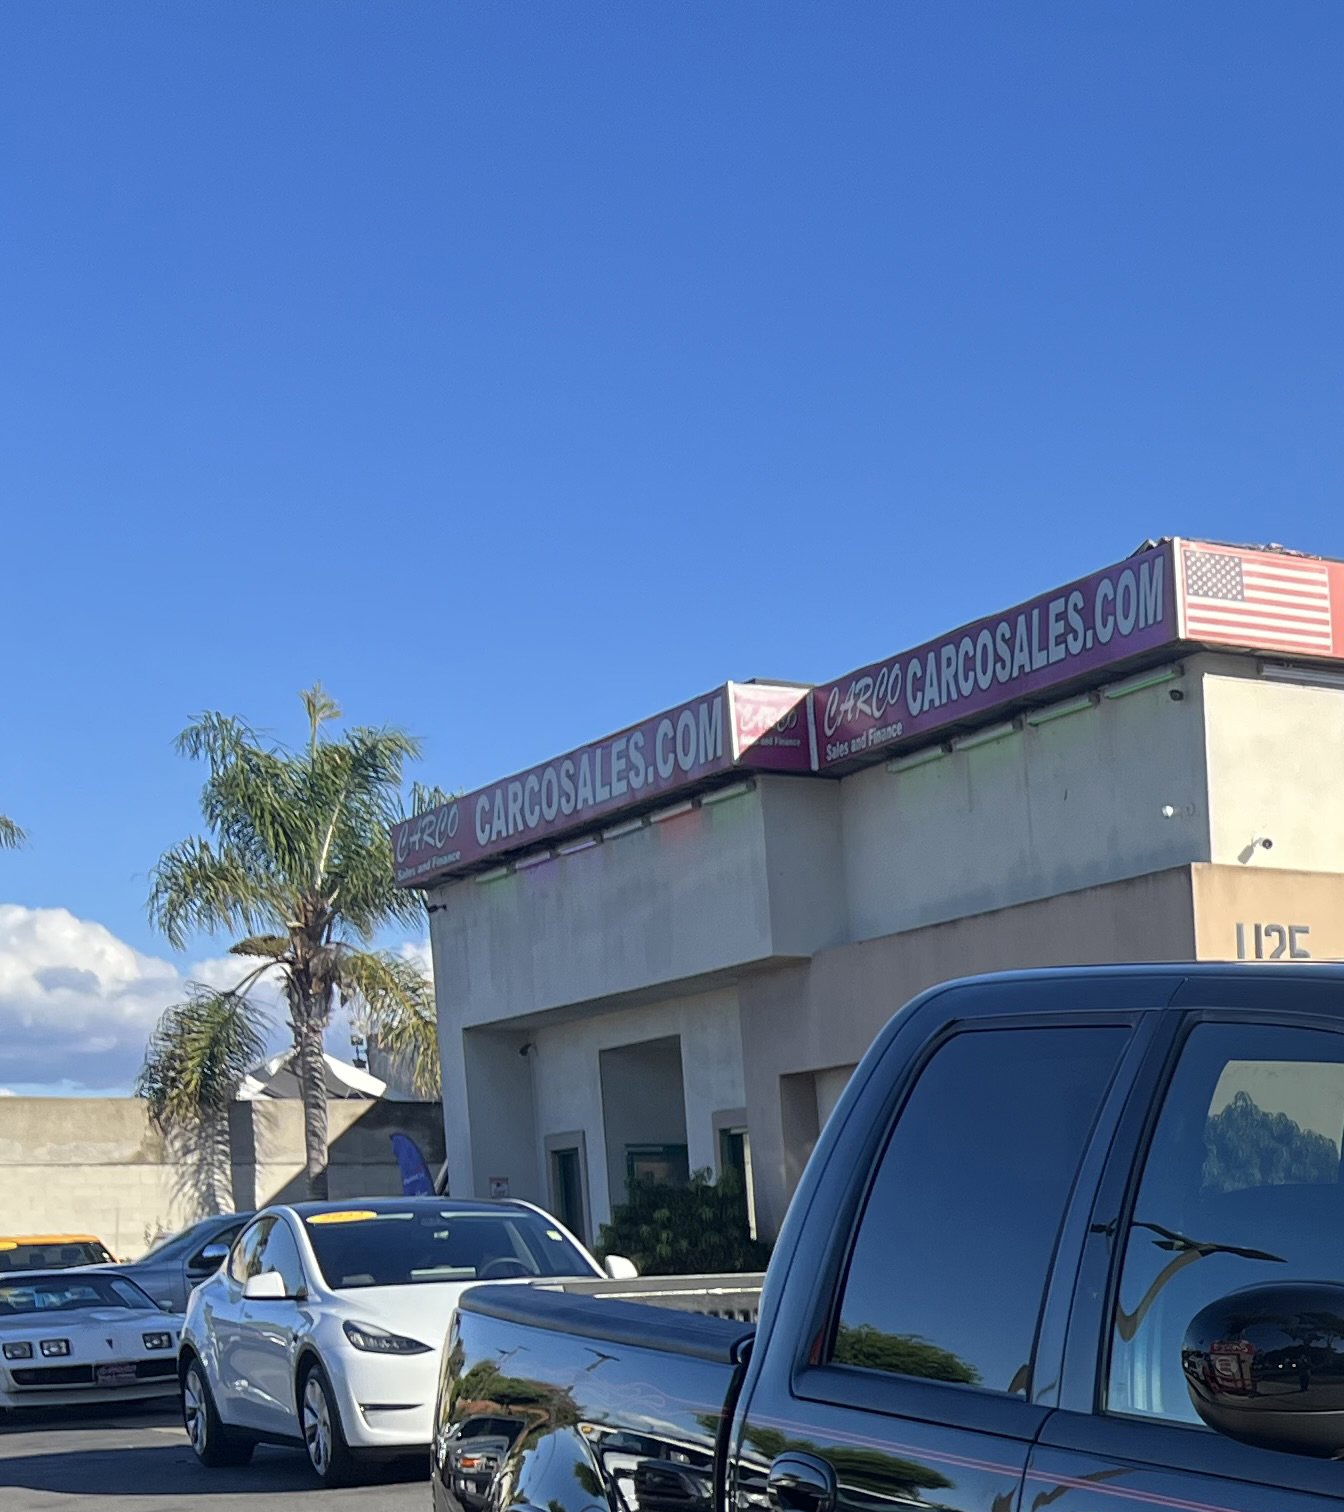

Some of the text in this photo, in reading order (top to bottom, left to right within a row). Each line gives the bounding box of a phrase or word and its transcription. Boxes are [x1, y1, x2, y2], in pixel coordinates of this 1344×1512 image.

[823, 555, 1165, 737] CARCO CARCOSALES.COM
[396, 696, 723, 864] CARCO CARCOSALES.COM
[826, 721, 903, 761] Sales and Finance
